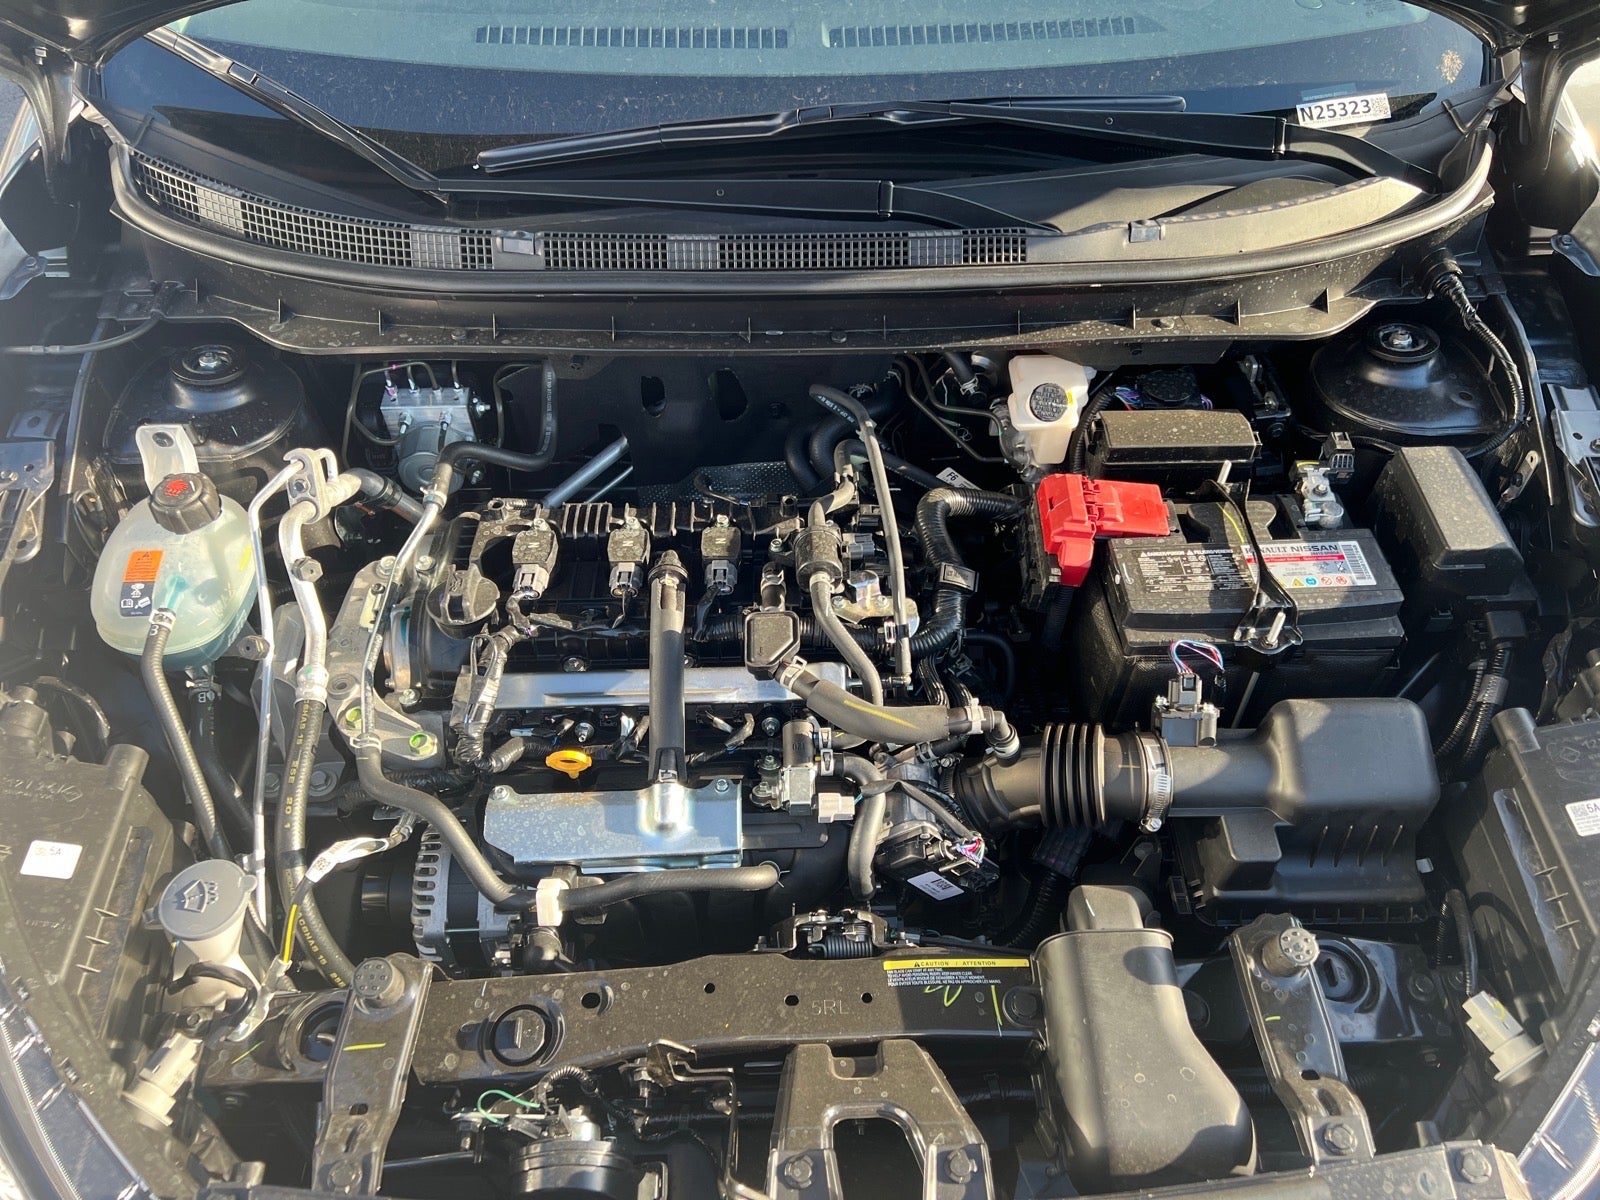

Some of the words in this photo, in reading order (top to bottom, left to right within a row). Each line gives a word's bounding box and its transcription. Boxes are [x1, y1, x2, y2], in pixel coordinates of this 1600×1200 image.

[1300, 100, 1372, 122] N25323
[946, 472, 958, 481] F6
[150, 624, 159, 636] 3
[812, 1000, 849, 1015] 5RL
